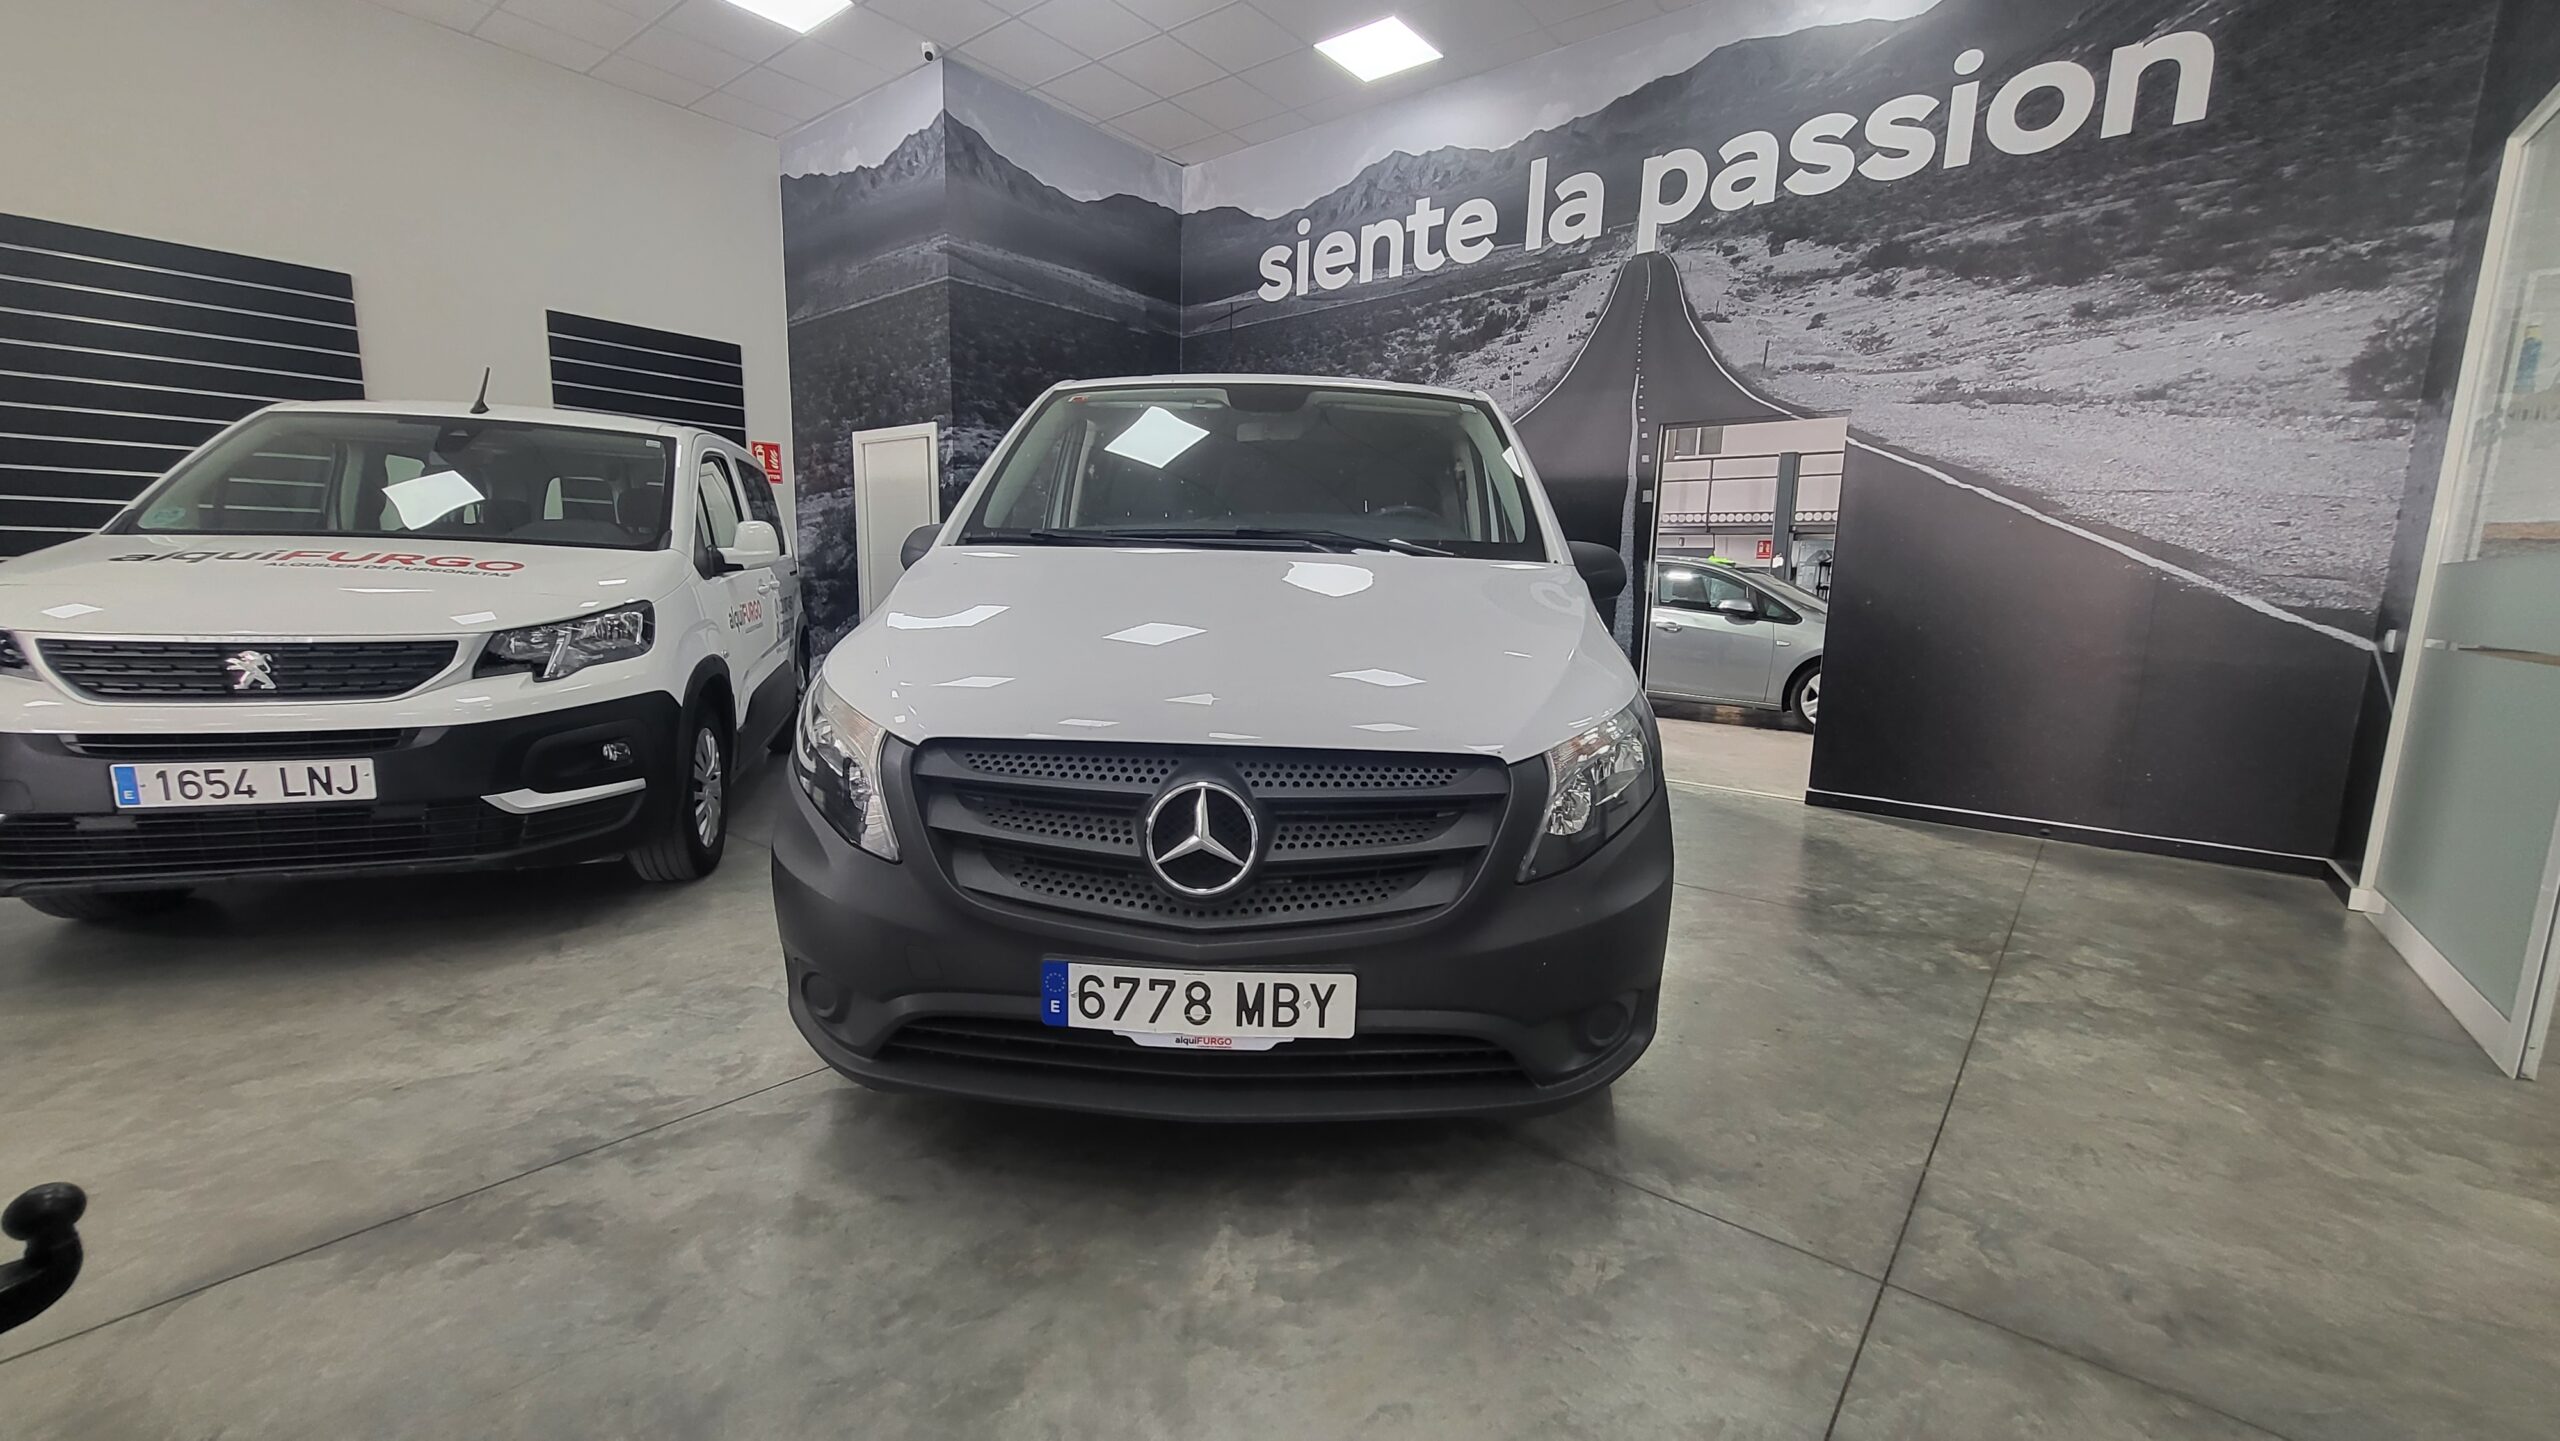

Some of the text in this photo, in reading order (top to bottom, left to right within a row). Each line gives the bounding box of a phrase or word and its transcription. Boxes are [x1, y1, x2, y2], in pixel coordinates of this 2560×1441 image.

[1257, 29, 2216, 302] siente la passion
[108, 549, 525, 572] alquiFURGO
[392, 565, 512, 577] FURGONETAS
[123, 765, 359, 800] E 1654 LNJ
[1050, 974, 1338, 1029] E 6778 MBY
[1175, 1036, 1232, 1046] alquiFURGO
